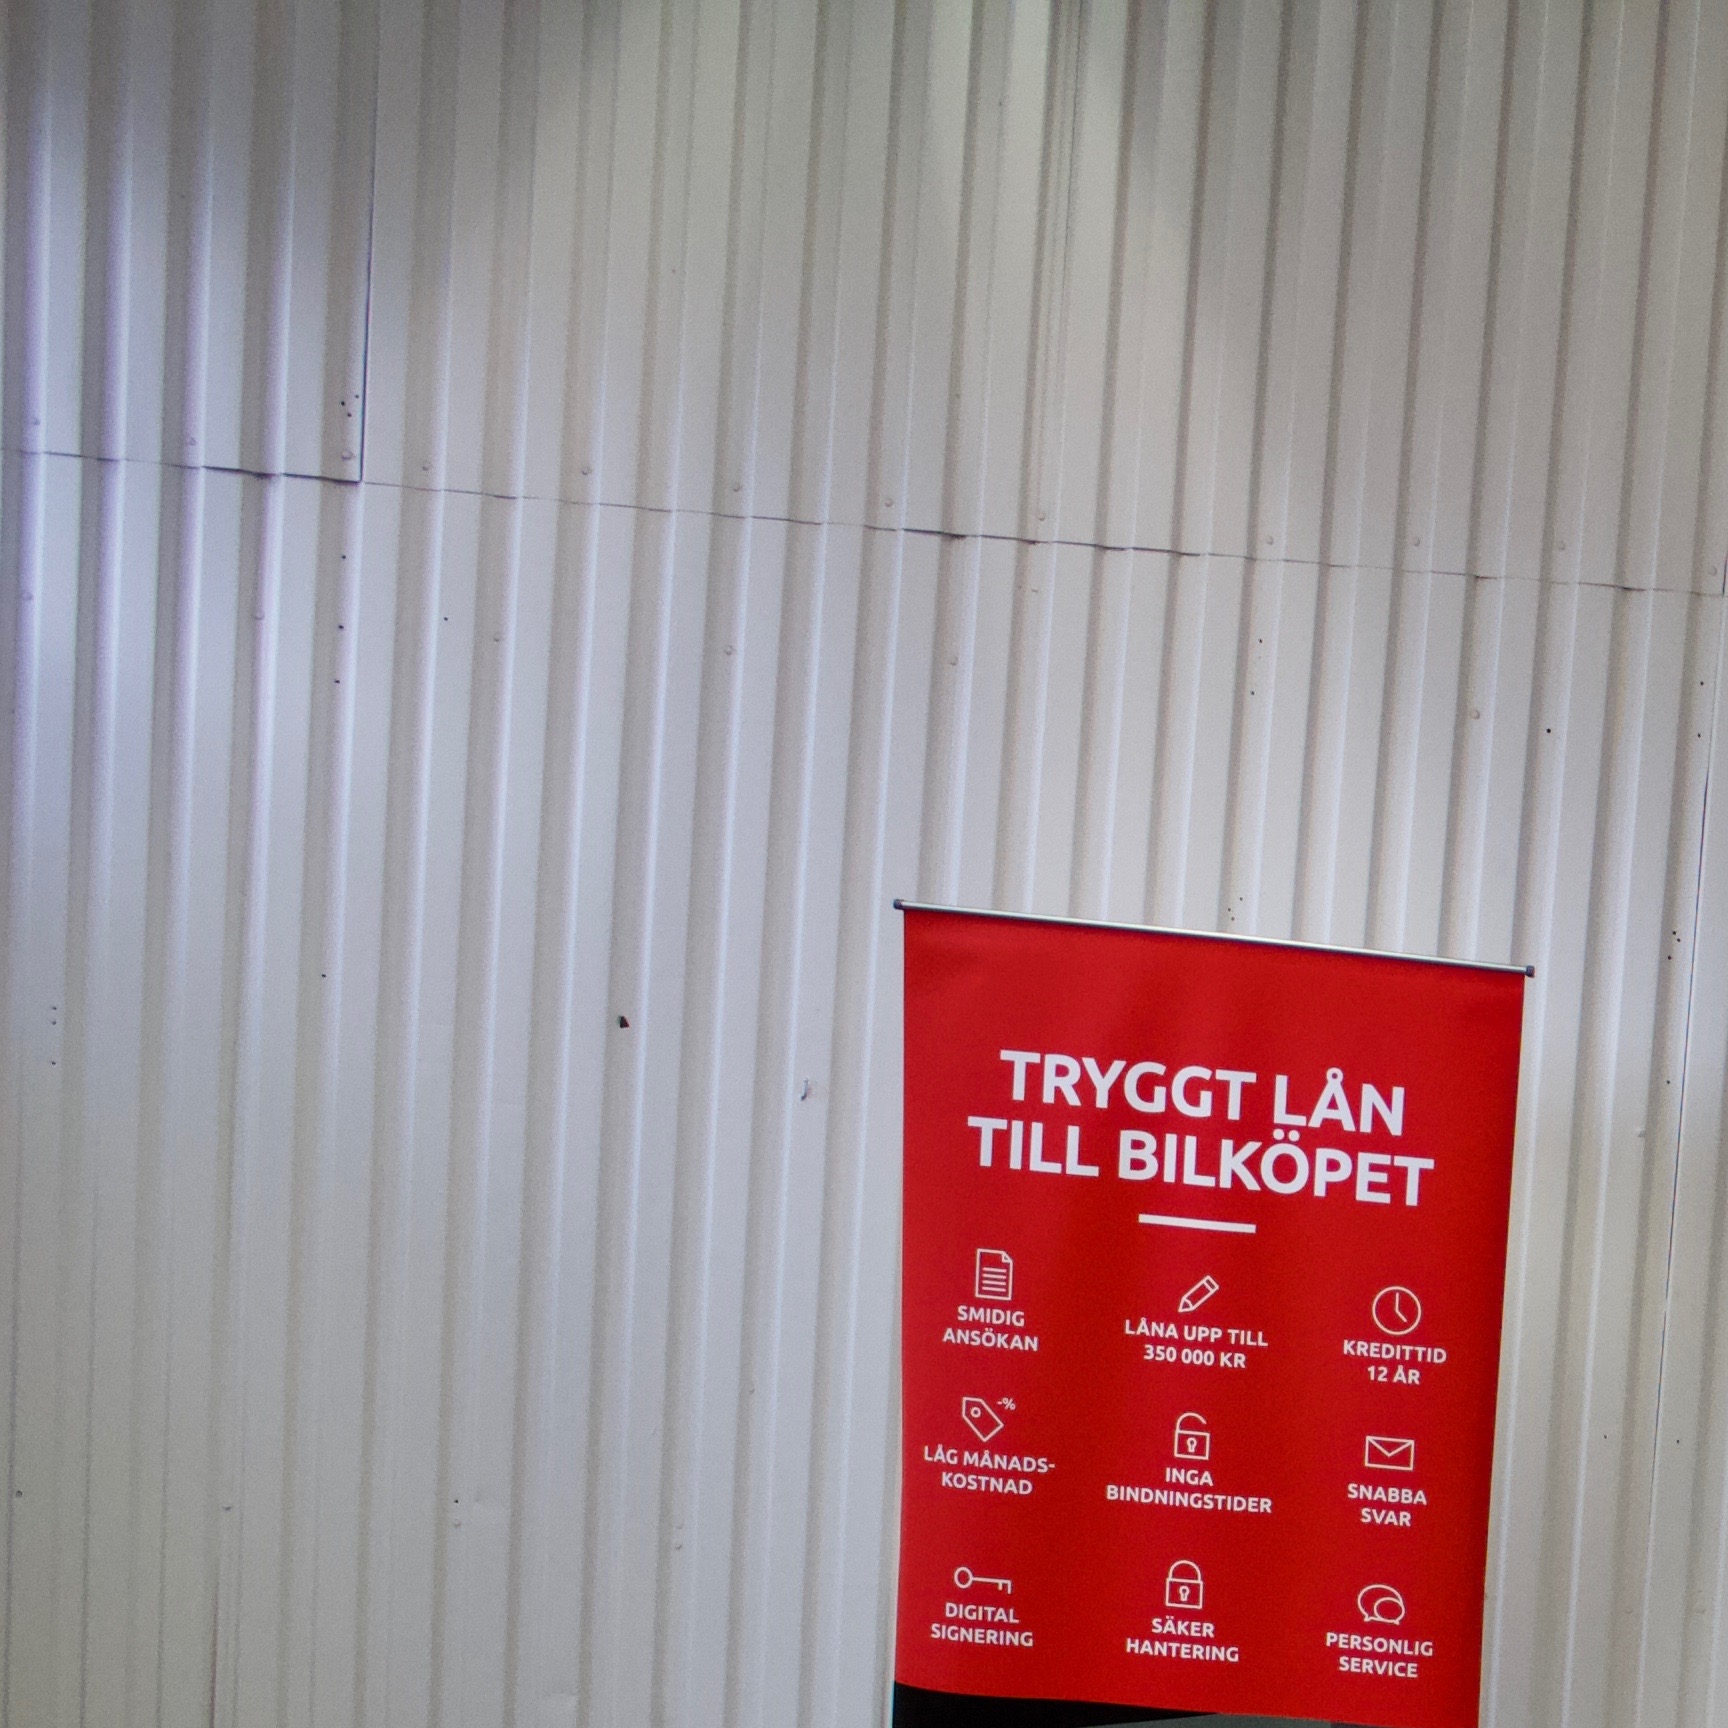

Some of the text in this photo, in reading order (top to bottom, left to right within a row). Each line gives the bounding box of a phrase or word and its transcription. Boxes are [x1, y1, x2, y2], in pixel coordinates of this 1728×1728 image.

[999, 1049, 1405, 1137] TRYGGT LÅN
[967, 1115, 1435, 1207] TILL BILKÖPET
[957, 1305, 1025, 1327] SMIDIG
[942, 1327, 1039, 1352] ANSÖKAN
[1124, 1316, 1269, 1347] LÅNA UPP TILL
[1143, 1343, 1246, 1369] 350 000 KR
[1343, 1339, 1447, 1364] KREDITTID
[1367, 1364, 1420, 1385] 12 ÅR
[924, 1443, 1056, 1474] LÅG MÅNADS-
[941, 1471, 1033, 1495] KOSTNAD
[1165, 1467, 1214, 1487] INGA
[1106, 1484, 1272, 1514] BINDNINGSTIDER
[1347, 1482, 1428, 1506] SNABBA
[1360, 1507, 1412, 1527] SVAR
[945, 1602, 1020, 1624] DIGITAL
[930, 1622, 1034, 1647] SIGNERING
[1151, 1615, 1215, 1638] SÄKER
[1126, 1637, 1239, 1663] HANTERING
[1325, 1631, 1433, 1657] PERSONLIG
[1338, 1658, 1418, 1678] SERVICE
